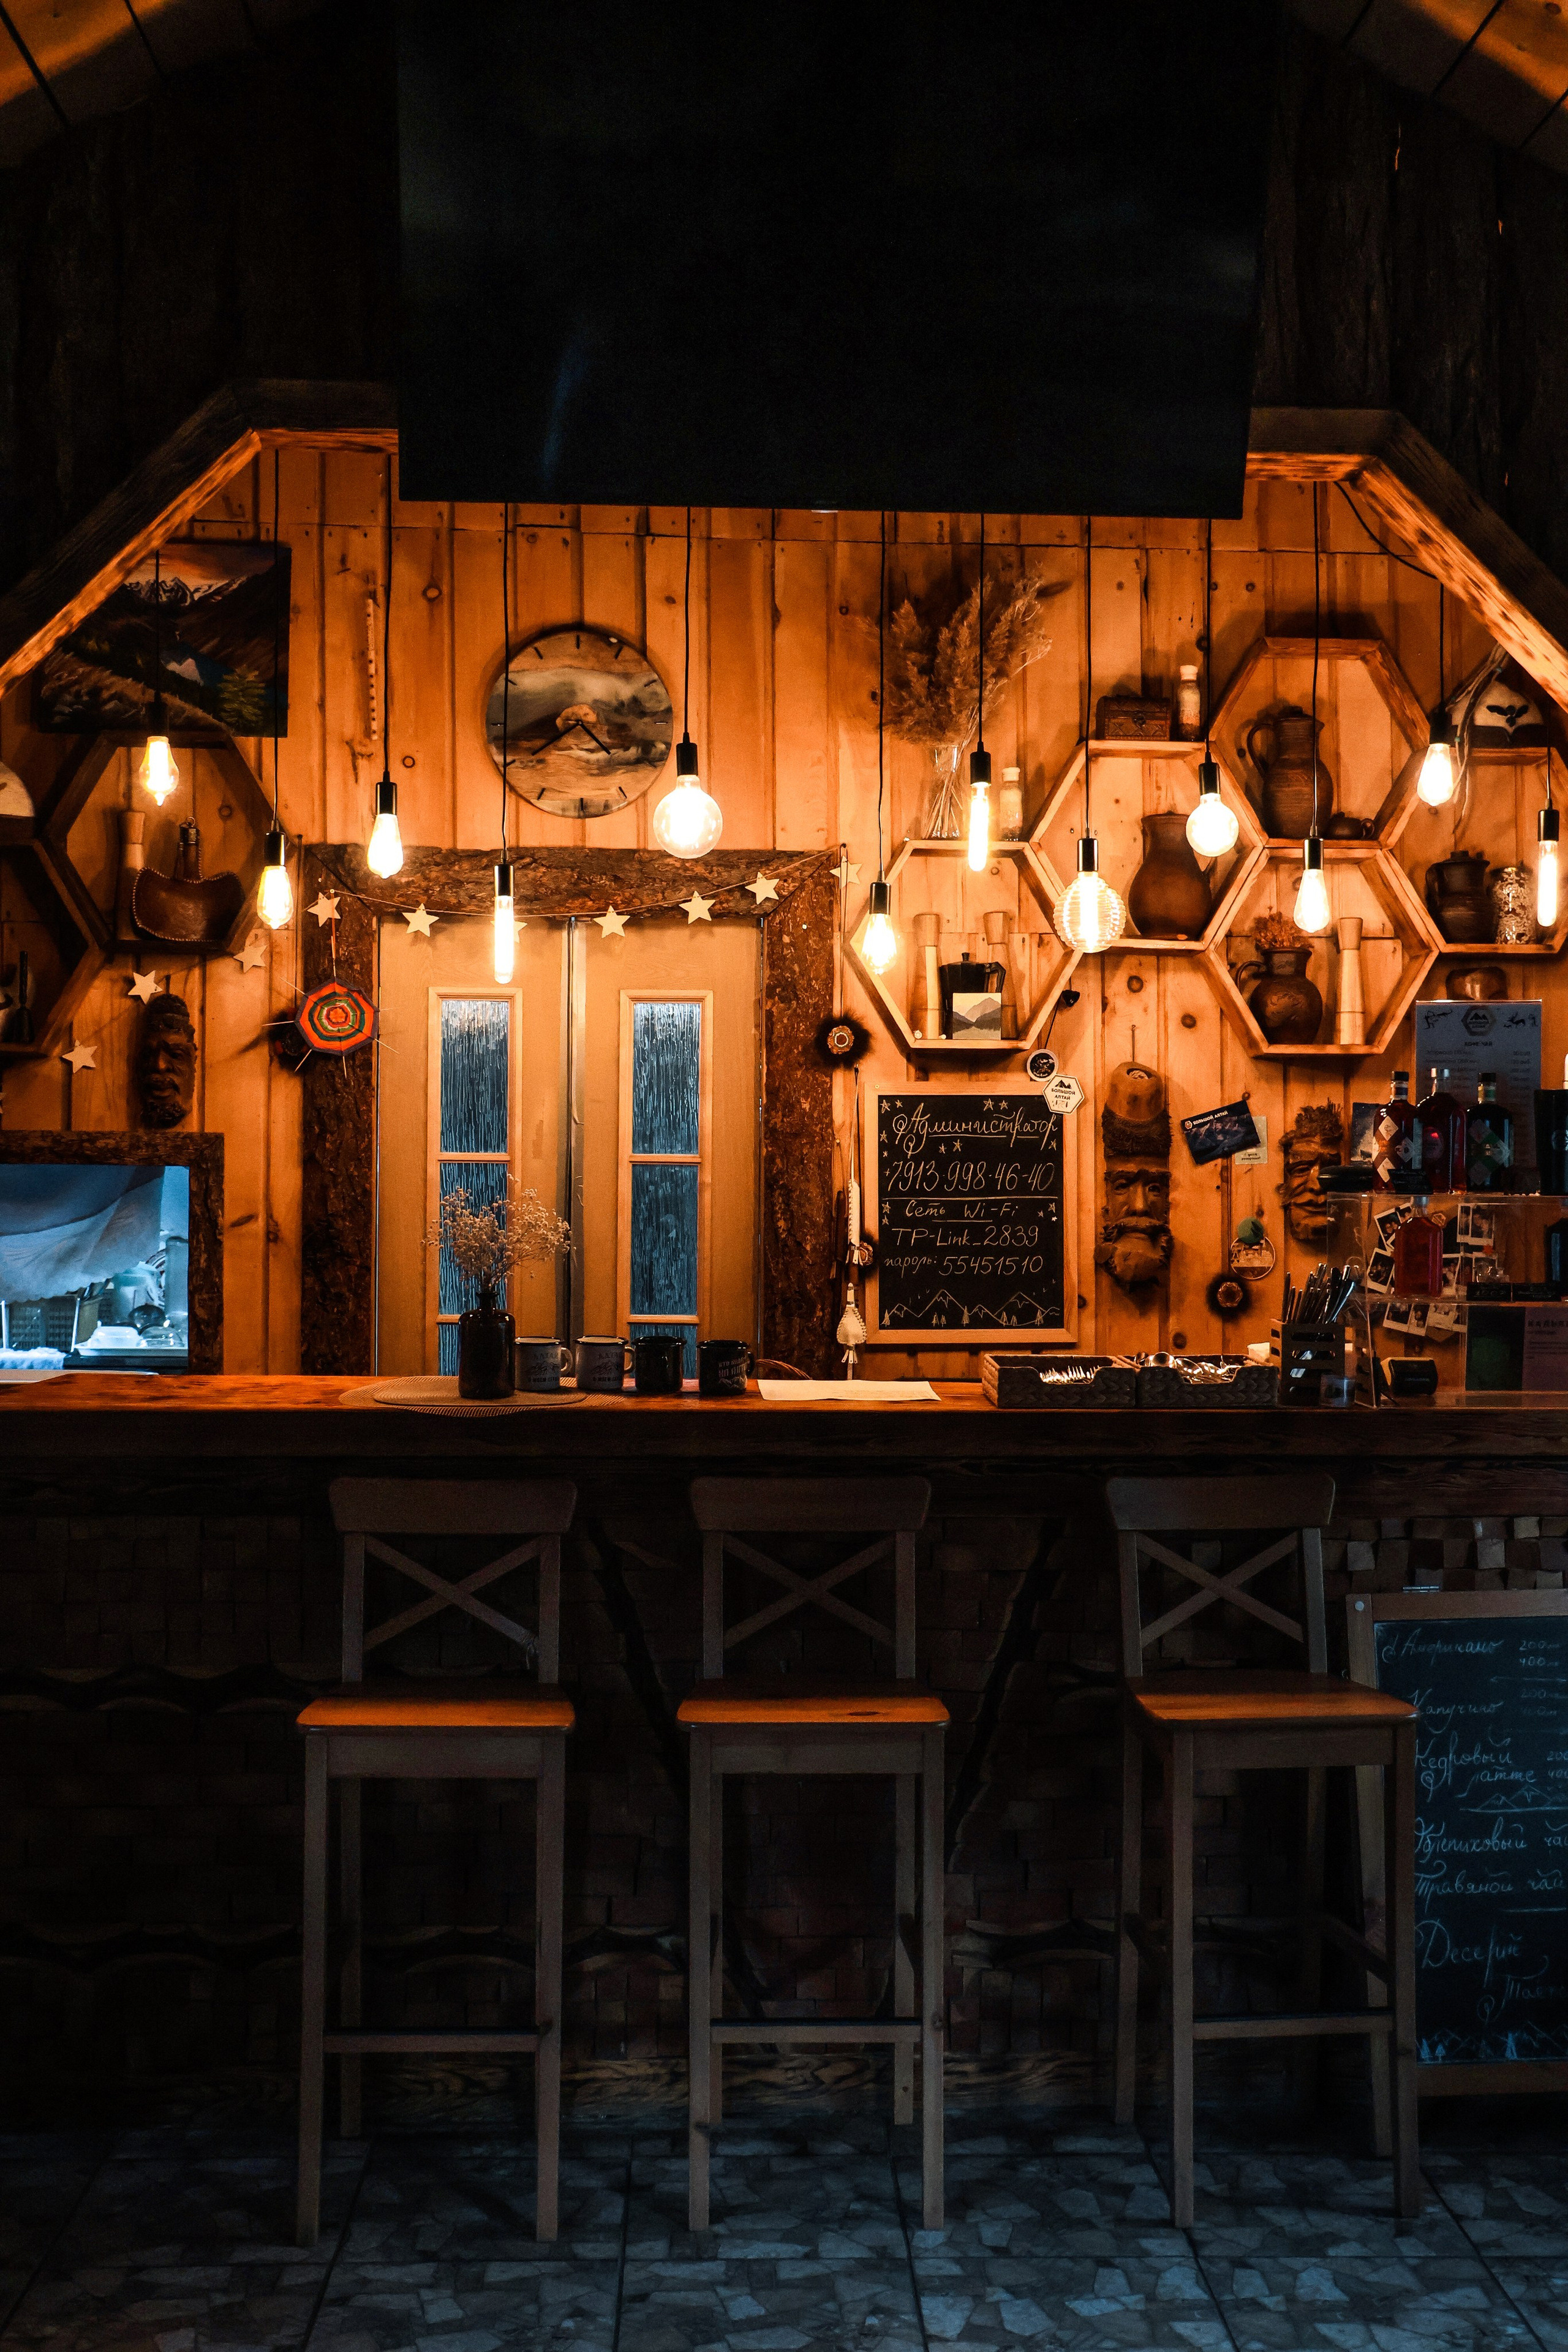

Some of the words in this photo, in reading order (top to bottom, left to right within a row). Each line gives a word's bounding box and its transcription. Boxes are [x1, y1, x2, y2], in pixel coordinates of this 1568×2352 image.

[1193, 1115, 1214, 1125] БОЛЬШОЙ
[1214, 1110, 1229, 1118] АЛТАЙ
[892, 1102, 1058, 1158] Администратор
[905, 1200, 946, 1217] Сеть
[964, 1202, 1018, 1218] Wi-Fi
[892, 1224, 1039, 1247] TP-Link_2839
[884, 1256, 937, 1278] пароль:
[939, 1256, 1043, 1276] 55451510
[1382, 1627, 1505, 1667] Американо
[1414, 1860, 1514, 1914] Травяной
